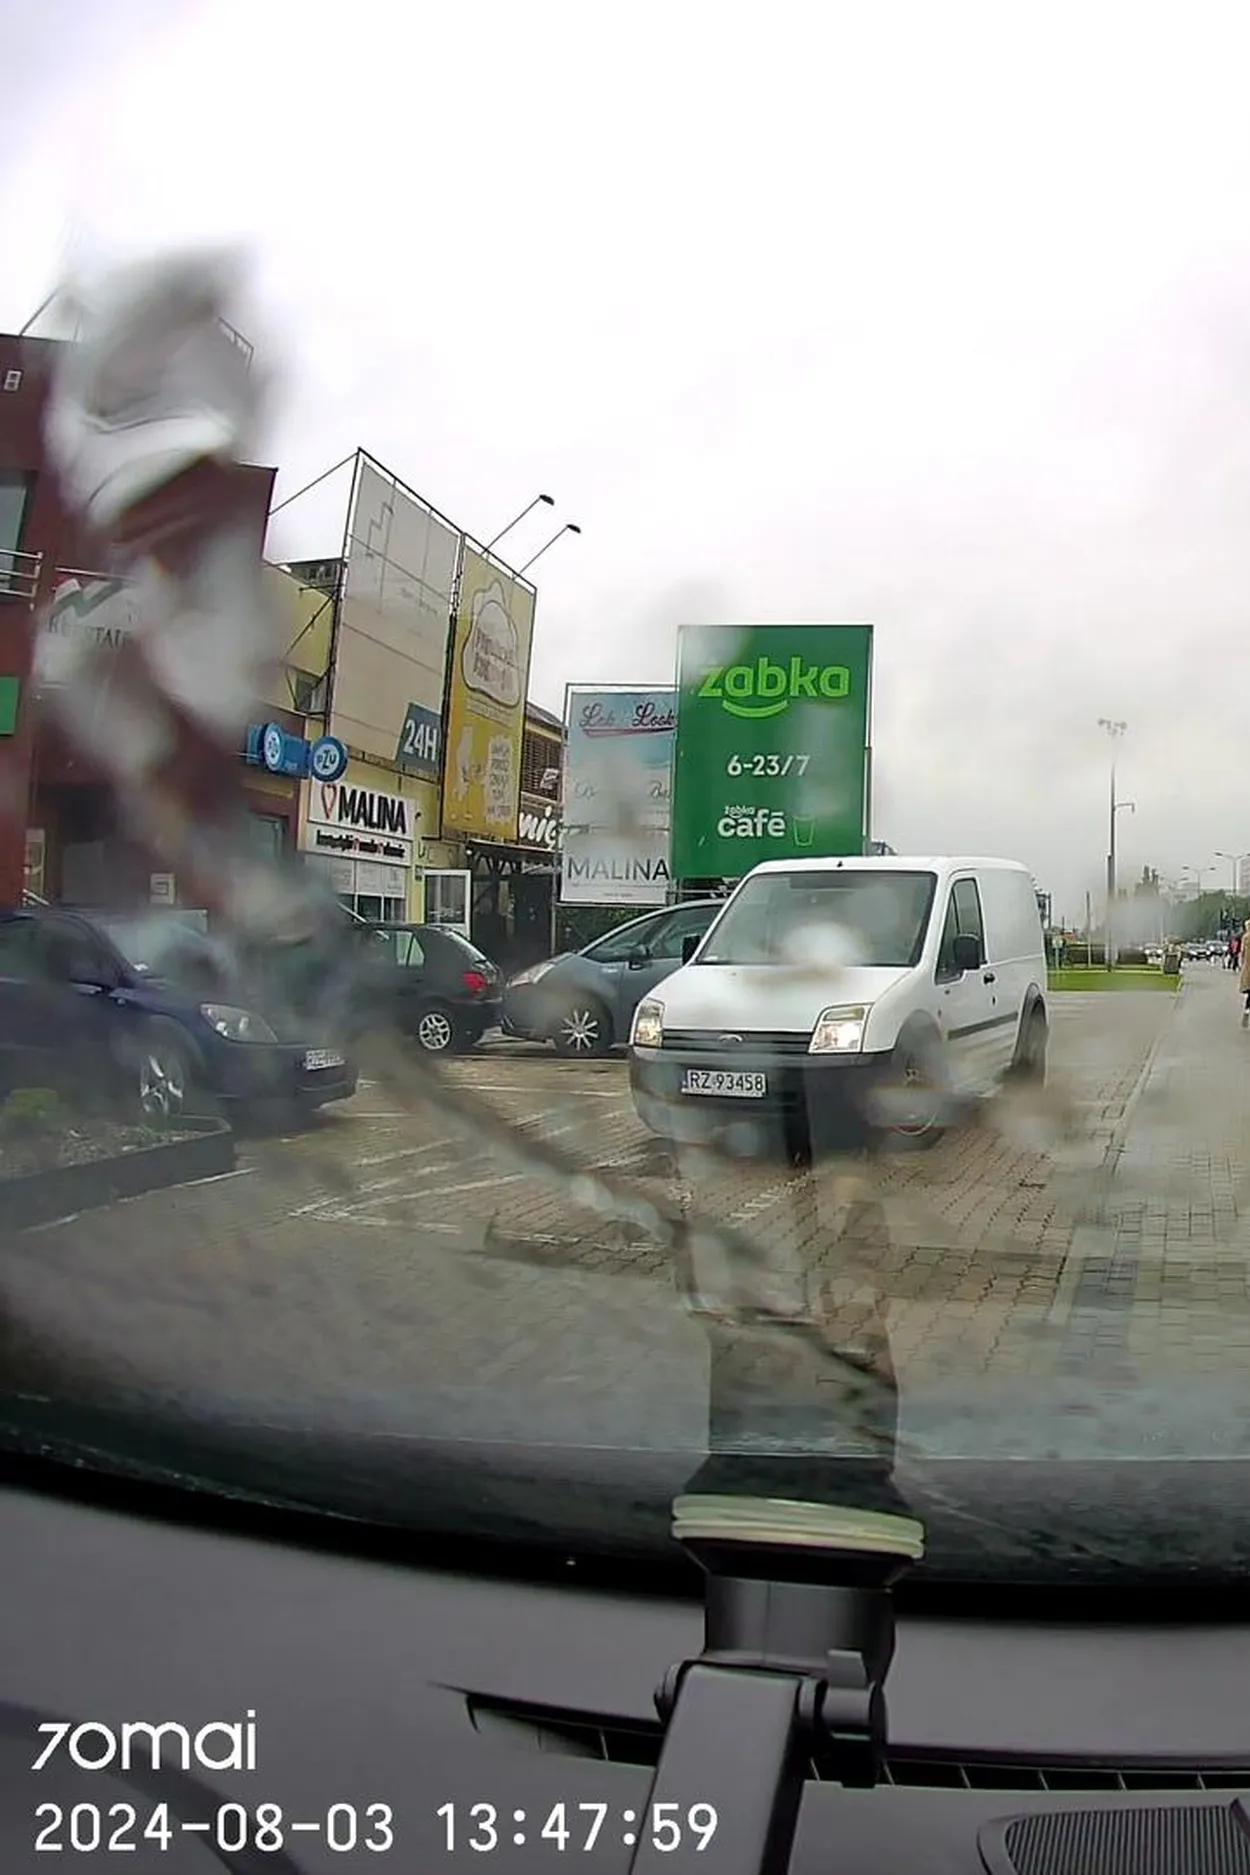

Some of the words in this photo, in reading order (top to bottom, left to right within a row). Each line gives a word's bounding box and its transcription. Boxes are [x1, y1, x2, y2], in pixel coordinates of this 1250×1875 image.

[403, 719, 438, 762] 24H
[727, 754, 811, 777] 6-23/7
[339, 785, 407, 835] MALINA
[567, 857, 670, 881] MALINA
[690, 1072, 712, 1089] RZ
[716, 1073, 764, 1091] 93458
